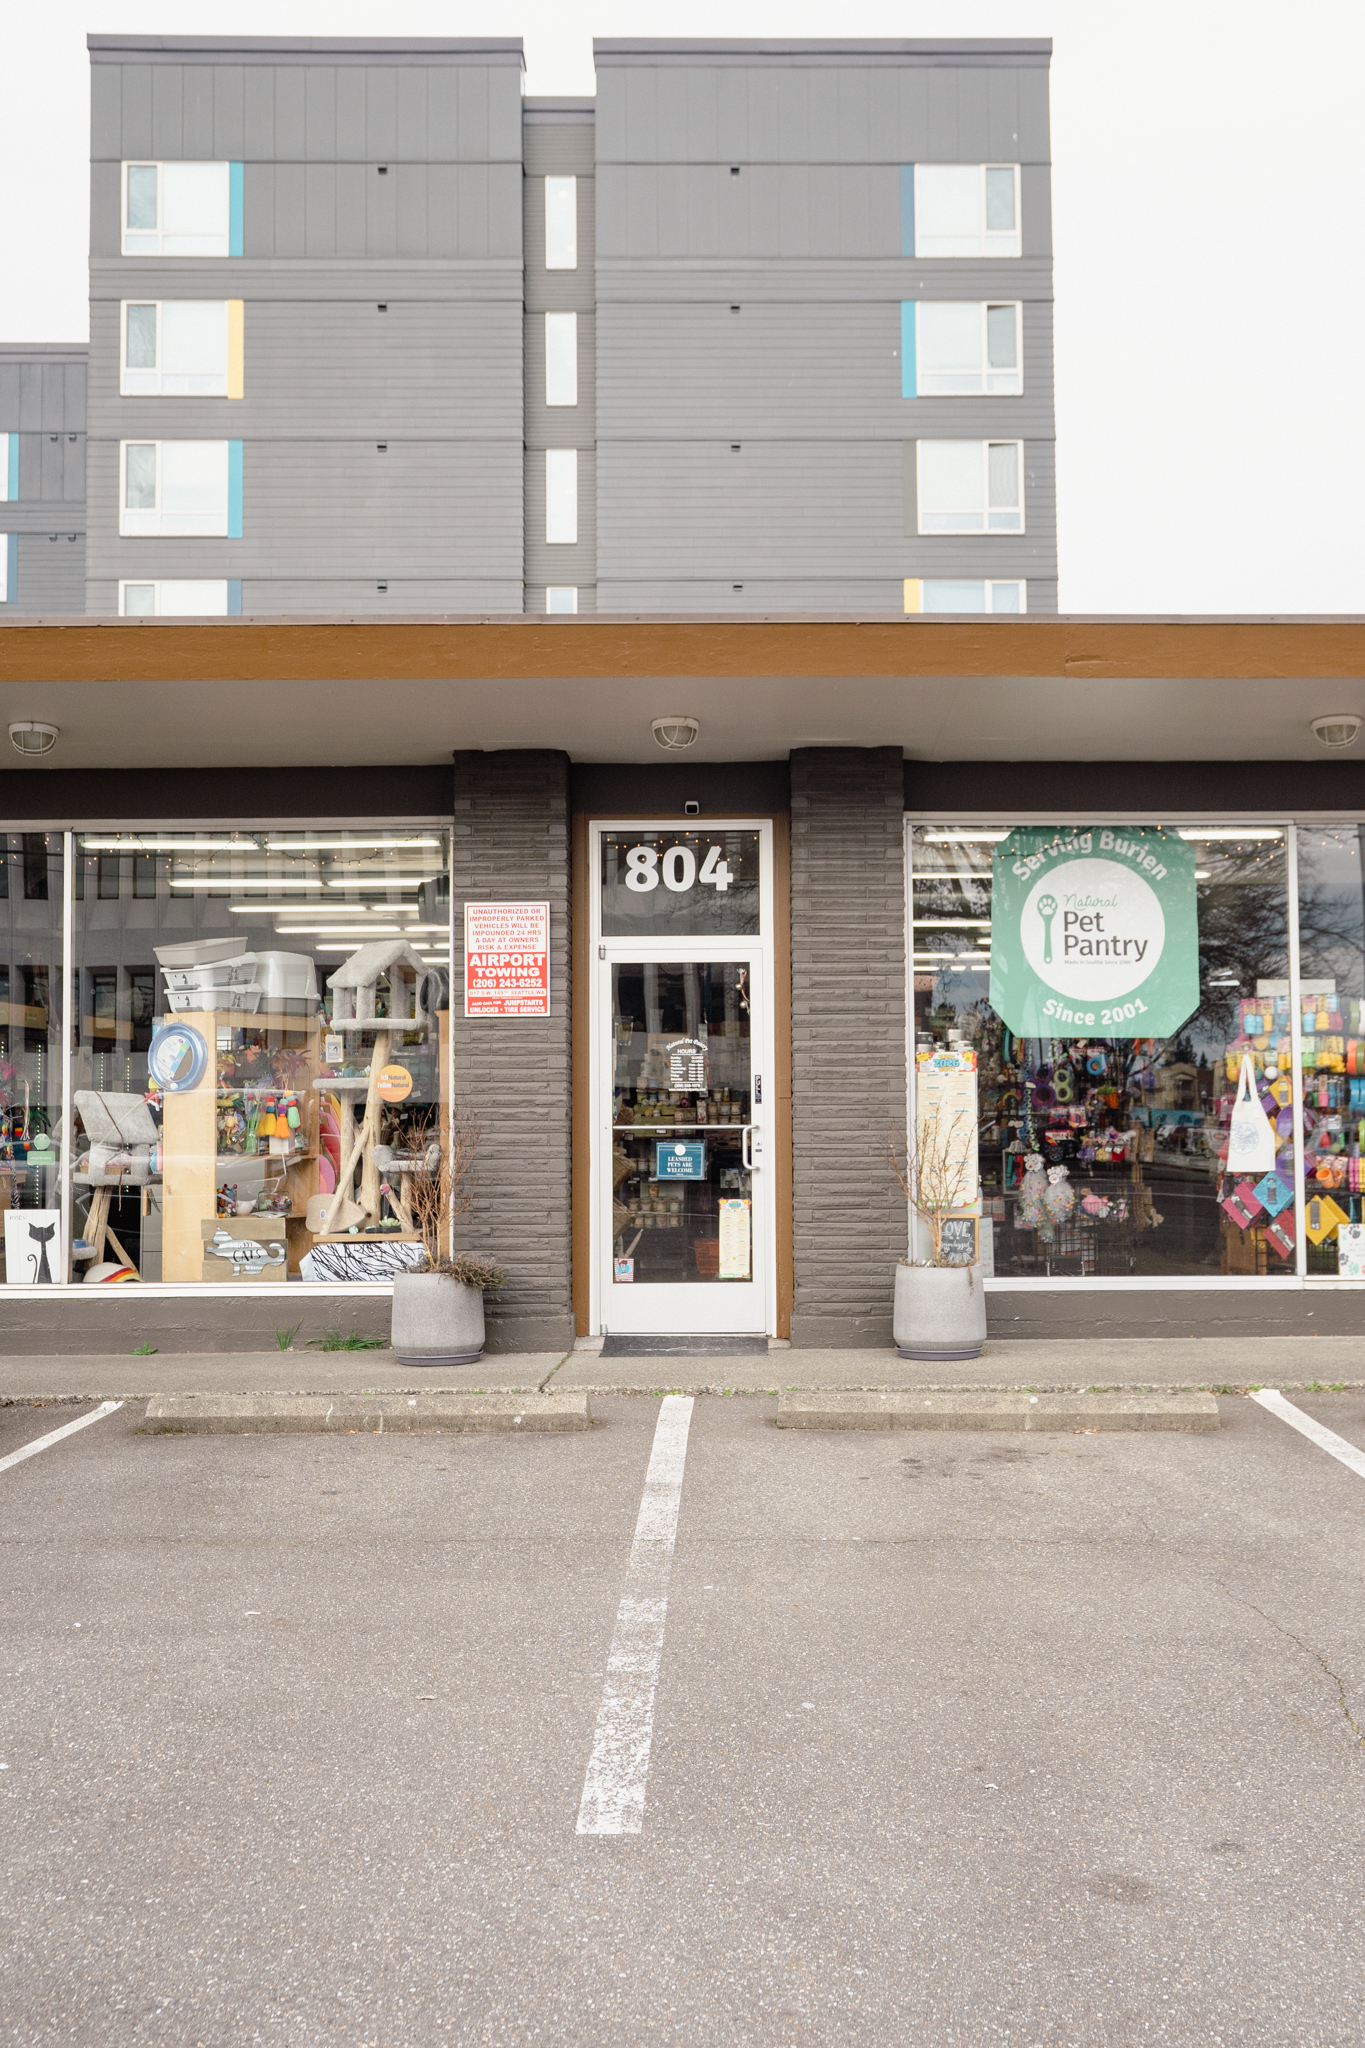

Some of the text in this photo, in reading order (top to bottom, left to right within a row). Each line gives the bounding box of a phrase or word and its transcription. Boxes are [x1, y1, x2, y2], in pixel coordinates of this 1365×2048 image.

[1012, 830, 1168, 881] Serving Burien
[625, 846, 734, 892] 804
[1064, 894, 1118, 911] Natural
[1064, 910, 1105, 932] Pet
[1064, 934, 1148, 962] Pantry
[469, 954, 546, 966] AIRPORT
[475, 968, 540, 977] TOWING
[472, 978, 542, 988] (206) 243-6252
[1042, 998, 1148, 1026] Since 2001
[933, 1058, 960, 1068] 2026
[233, 1249, 261, 1262] CATS
